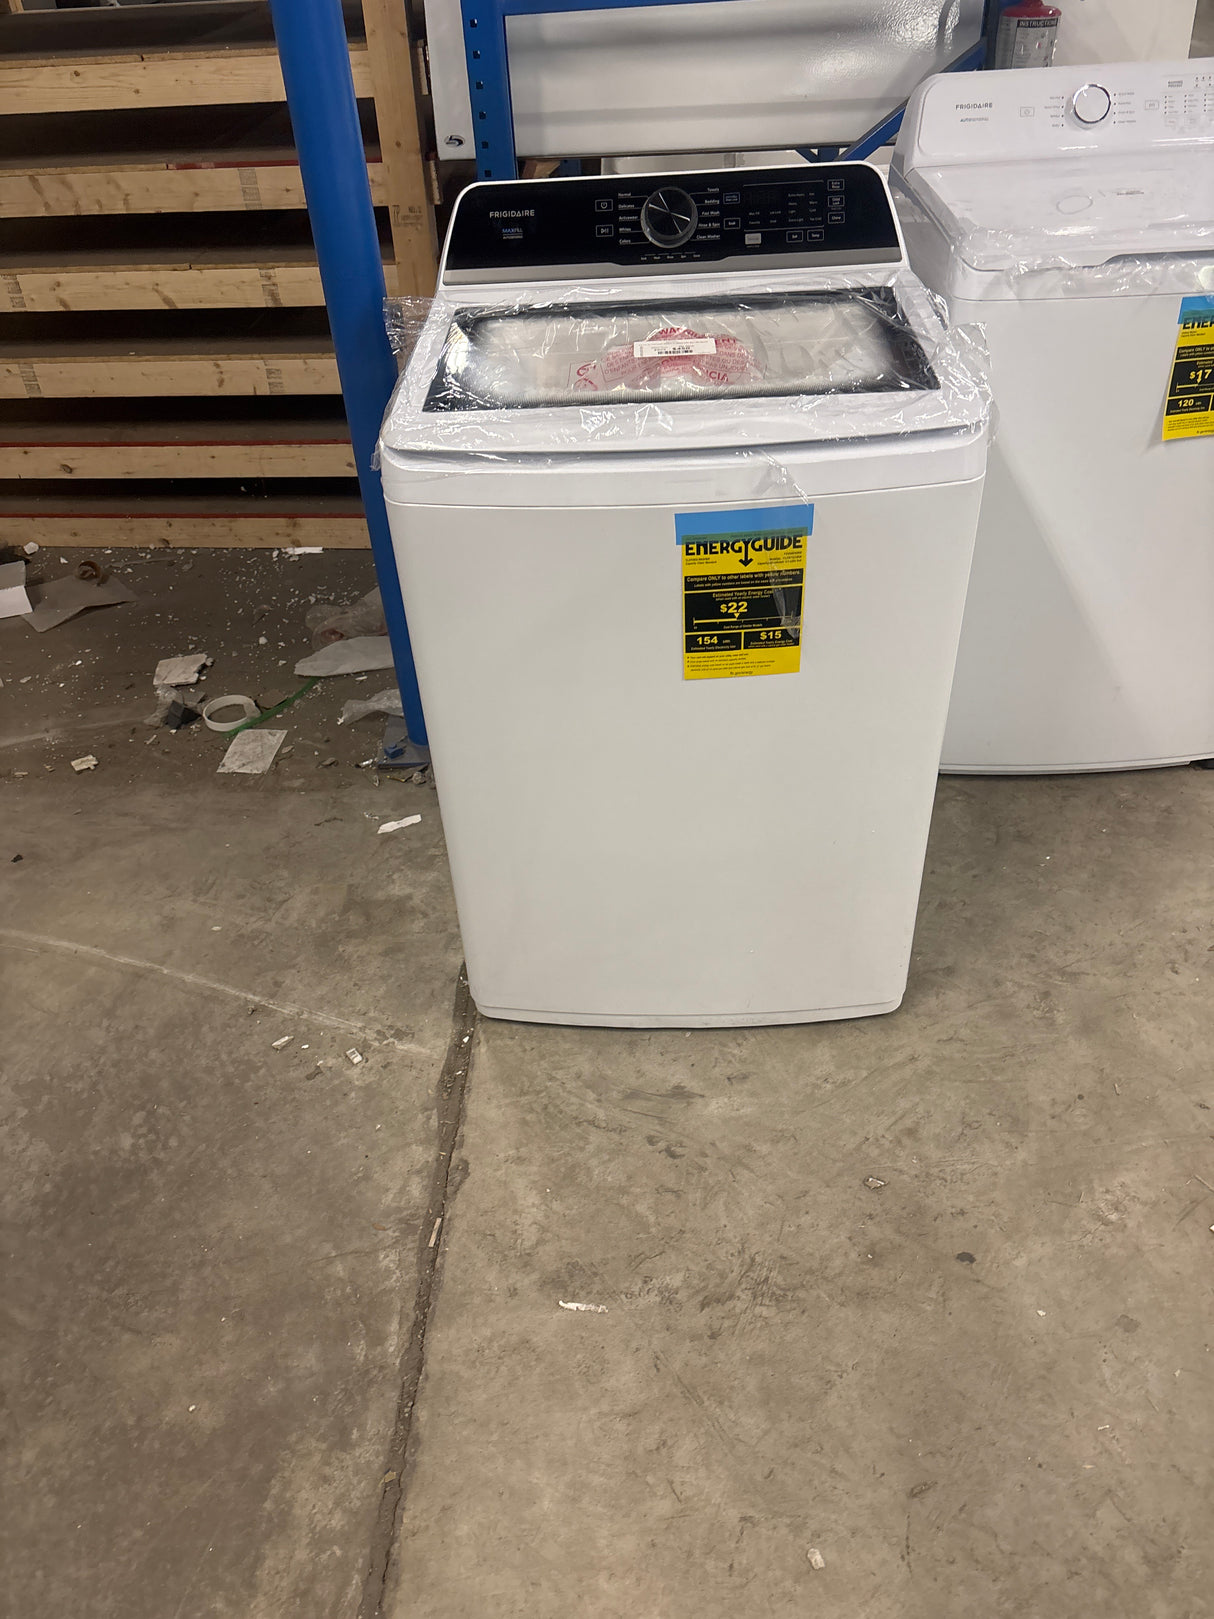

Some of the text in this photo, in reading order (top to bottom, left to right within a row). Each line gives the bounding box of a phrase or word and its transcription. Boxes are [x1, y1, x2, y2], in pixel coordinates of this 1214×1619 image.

[955, 102, 993, 110] FRIGIDAIRE
[489, 209, 536, 218] FRIGIDAIRE
[1189, 369, 1212, 379] $17
[1178, 399, 1194, 407] 120
[685, 535, 803, 556] ENERGYGUIDE
[720, 601, 748, 614] $22
[696, 635, 718, 645] 154
[759, 630, 782, 640] $15
